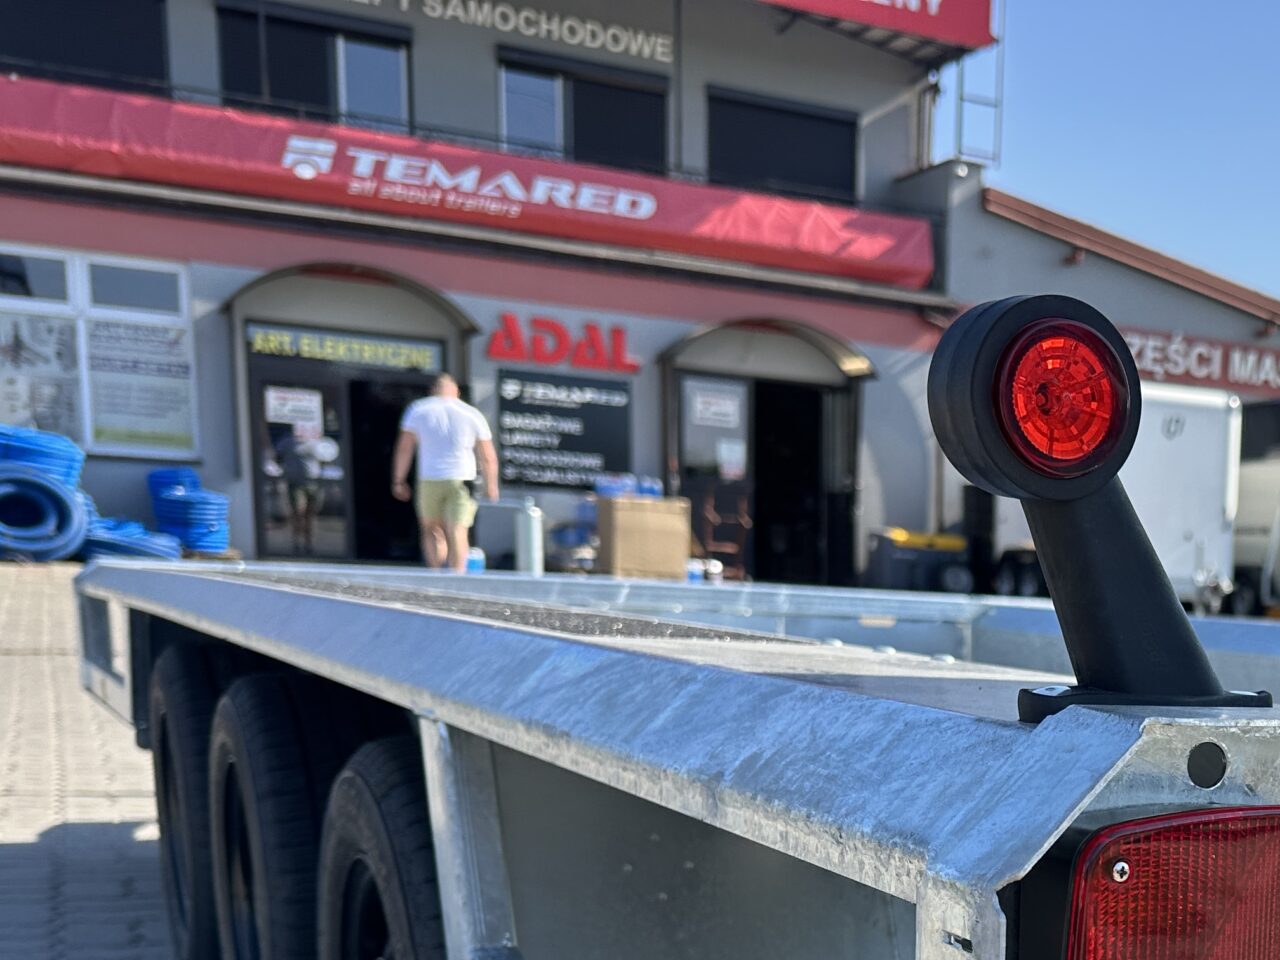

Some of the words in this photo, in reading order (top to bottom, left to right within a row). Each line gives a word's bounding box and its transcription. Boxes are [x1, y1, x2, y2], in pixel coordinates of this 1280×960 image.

[421, 0, 674, 62] SAMOCHODOWE
[346, 146, 658, 220] TEMARED
[347, 178, 377, 197] all
[378, 184, 441, 207] about
[445, 190, 521, 219] trailers
[298, 333, 433, 369] ELEKTRYCZNE
[489, 312, 641, 374] ADAL
